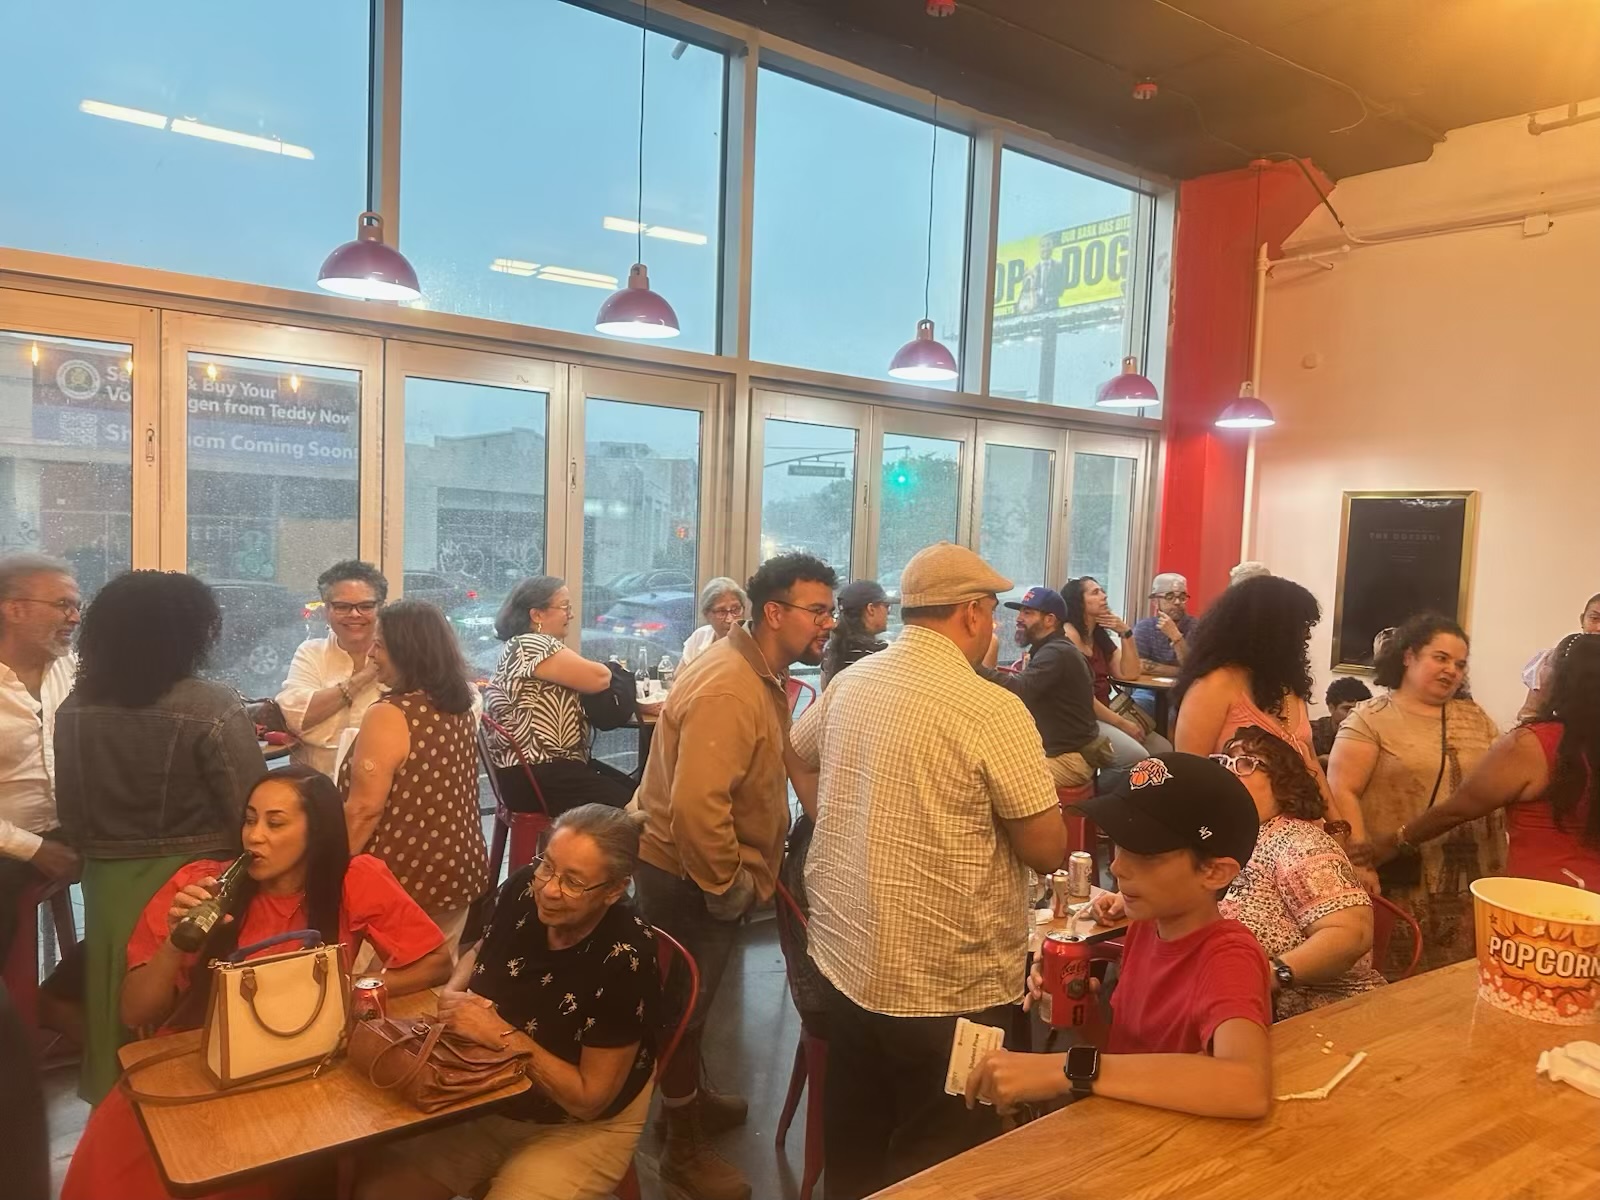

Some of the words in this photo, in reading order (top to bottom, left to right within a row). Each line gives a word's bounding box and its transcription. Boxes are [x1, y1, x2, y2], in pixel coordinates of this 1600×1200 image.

[1062, 235, 1129, 289] DOG
[203, 378, 237, 398] Buy
[240, 382, 278, 400] Your
[224, 399, 265, 417] from
[269, 403, 317, 425] Teddy
[231, 434, 304, 460] Coming
[1489, 935, 1600, 978] POPCORN
